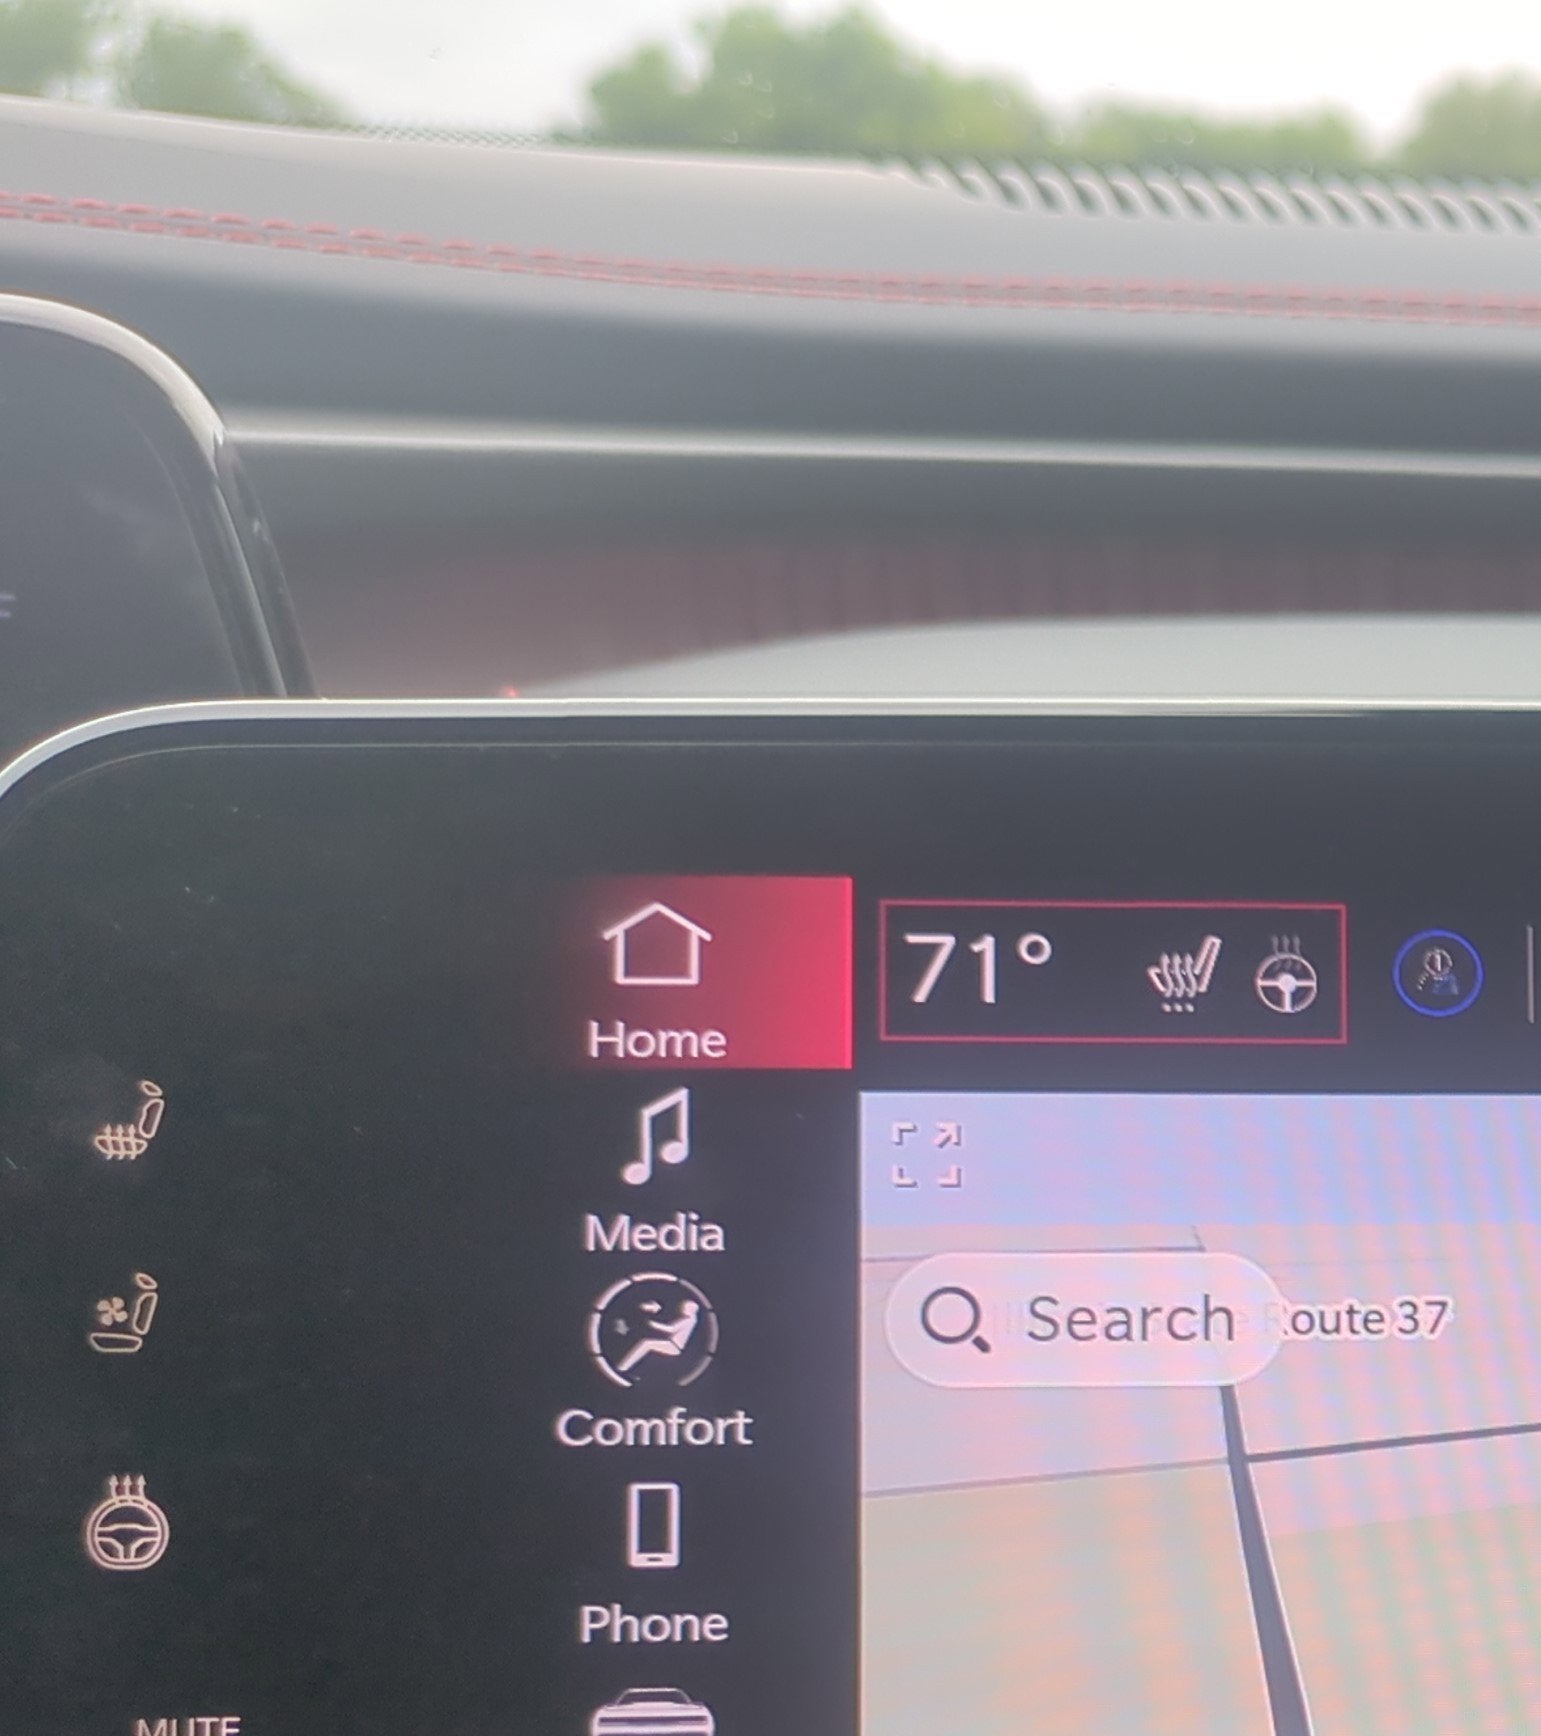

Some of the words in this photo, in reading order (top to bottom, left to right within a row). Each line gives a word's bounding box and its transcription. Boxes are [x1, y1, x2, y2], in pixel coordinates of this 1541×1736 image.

[903, 930, 1053, 1004] 71°
[586, 1021, 728, 1060] Home
[584, 1213, 726, 1253] Media
[1024, 1292, 1236, 1344] Search
[1397, 1298, 1449, 1336] 37
[556, 1408, 754, 1449] Comfort
[580, 1604, 730, 1644] Phone
